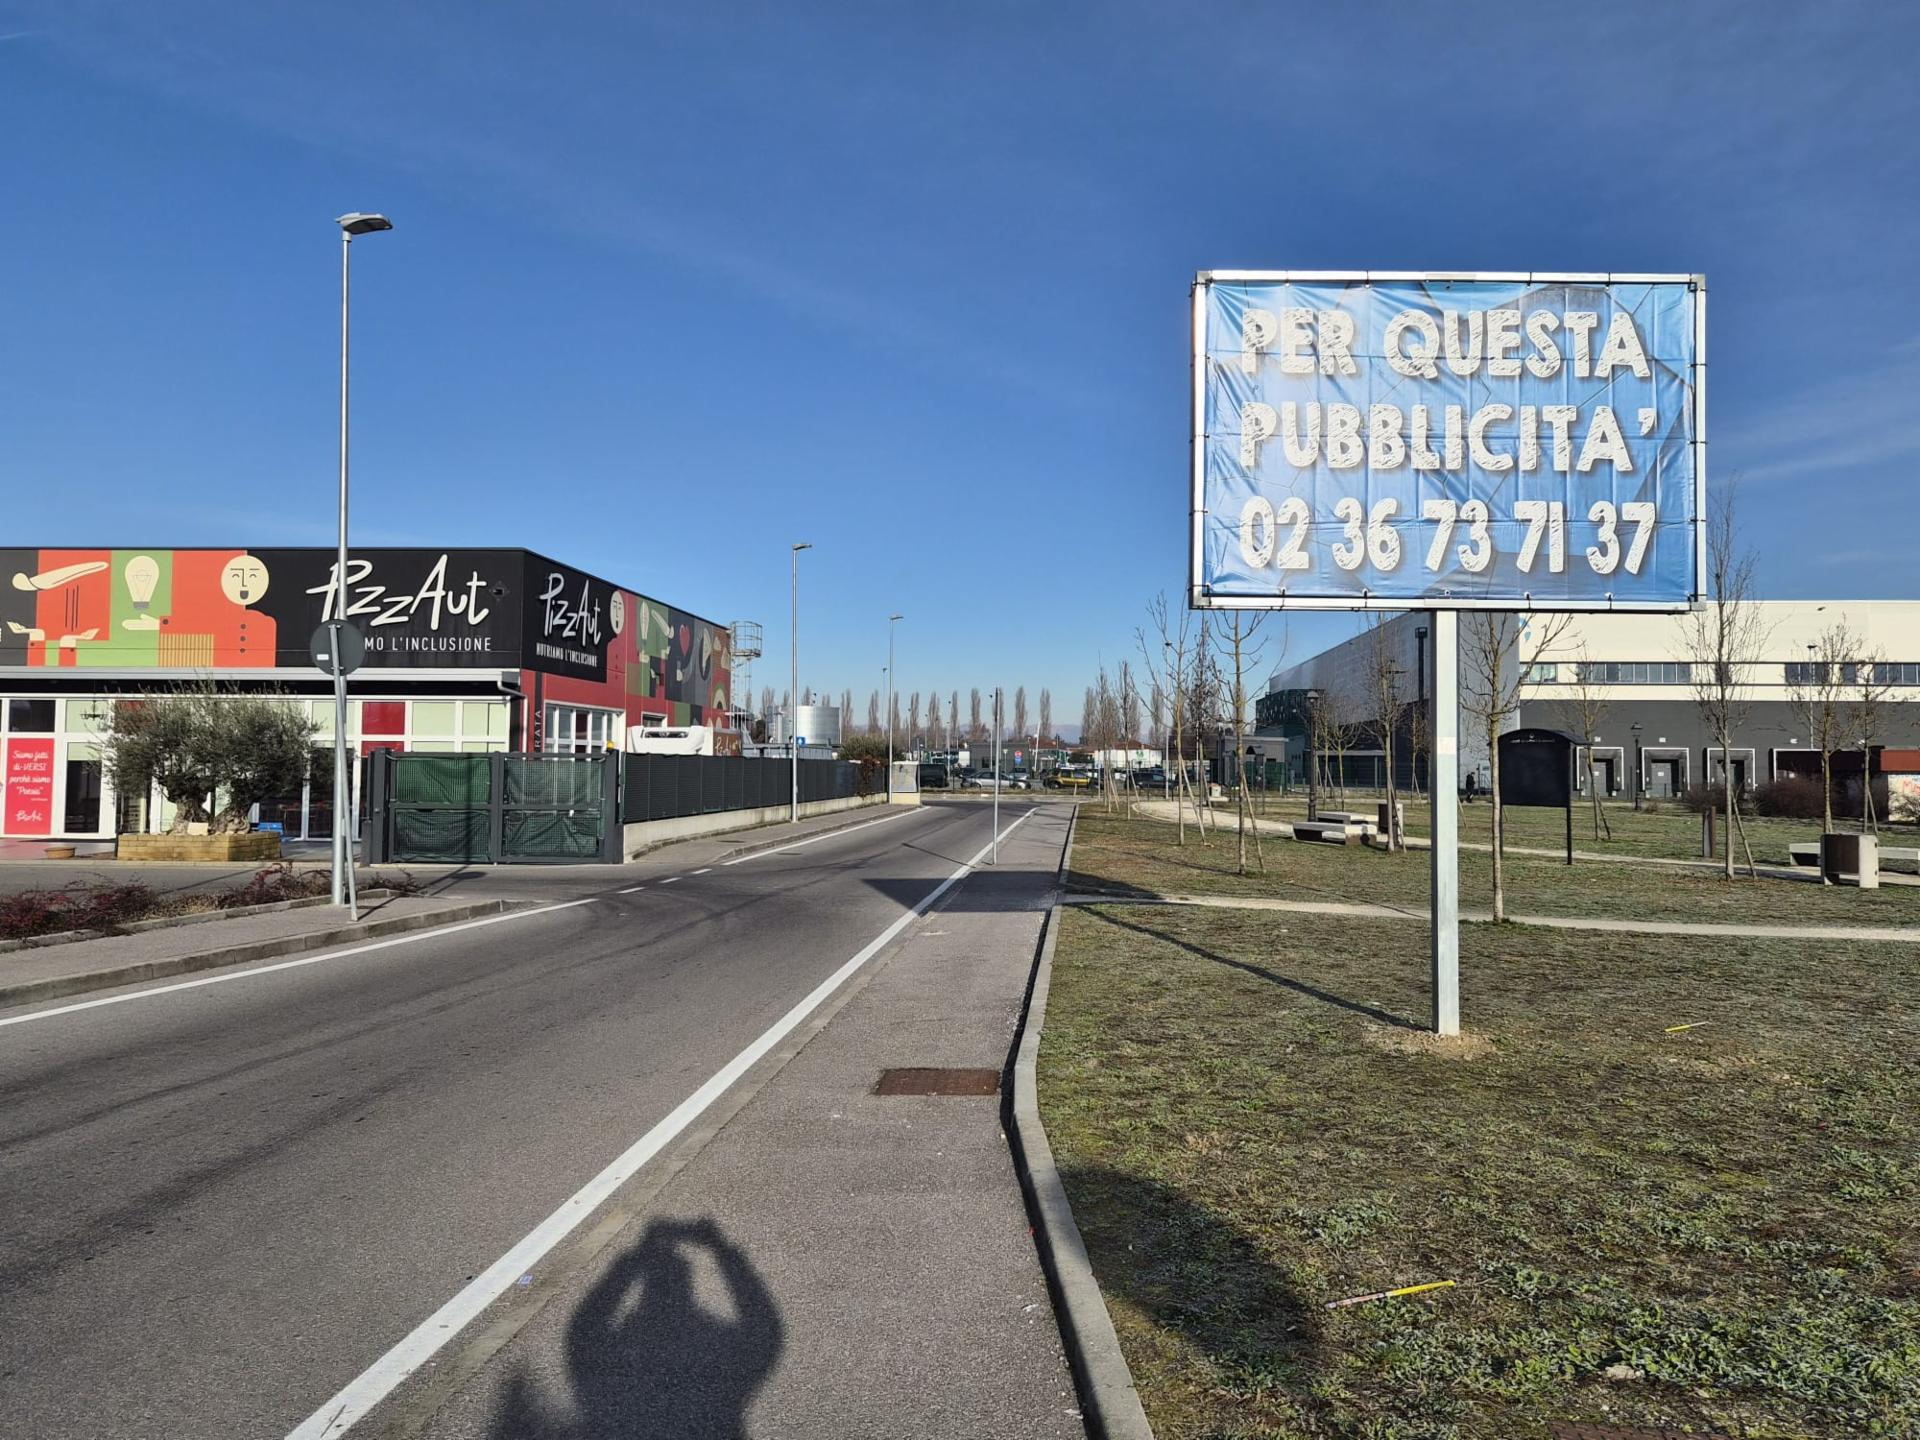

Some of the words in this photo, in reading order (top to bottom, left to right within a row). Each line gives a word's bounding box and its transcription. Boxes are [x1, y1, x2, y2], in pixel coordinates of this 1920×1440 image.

[1241, 308, 1357, 376] PER
[1383, 310, 1651, 379] QUESTA
[1240, 496, 1310, 569] 02
[1332, 497, 1401, 572] 36
[1424, 499, 1492, 573] 73
[1515, 500, 1564, 574] 71
[1585, 501, 1656, 575] 37
[392, 637, 491, 651] L'INCLUSIONE
[539, 572, 602, 647] PizzAut
[536, 642, 564, 660] NUTRIAMO
[565, 649, 598, 667] L'INCLUSIONE
